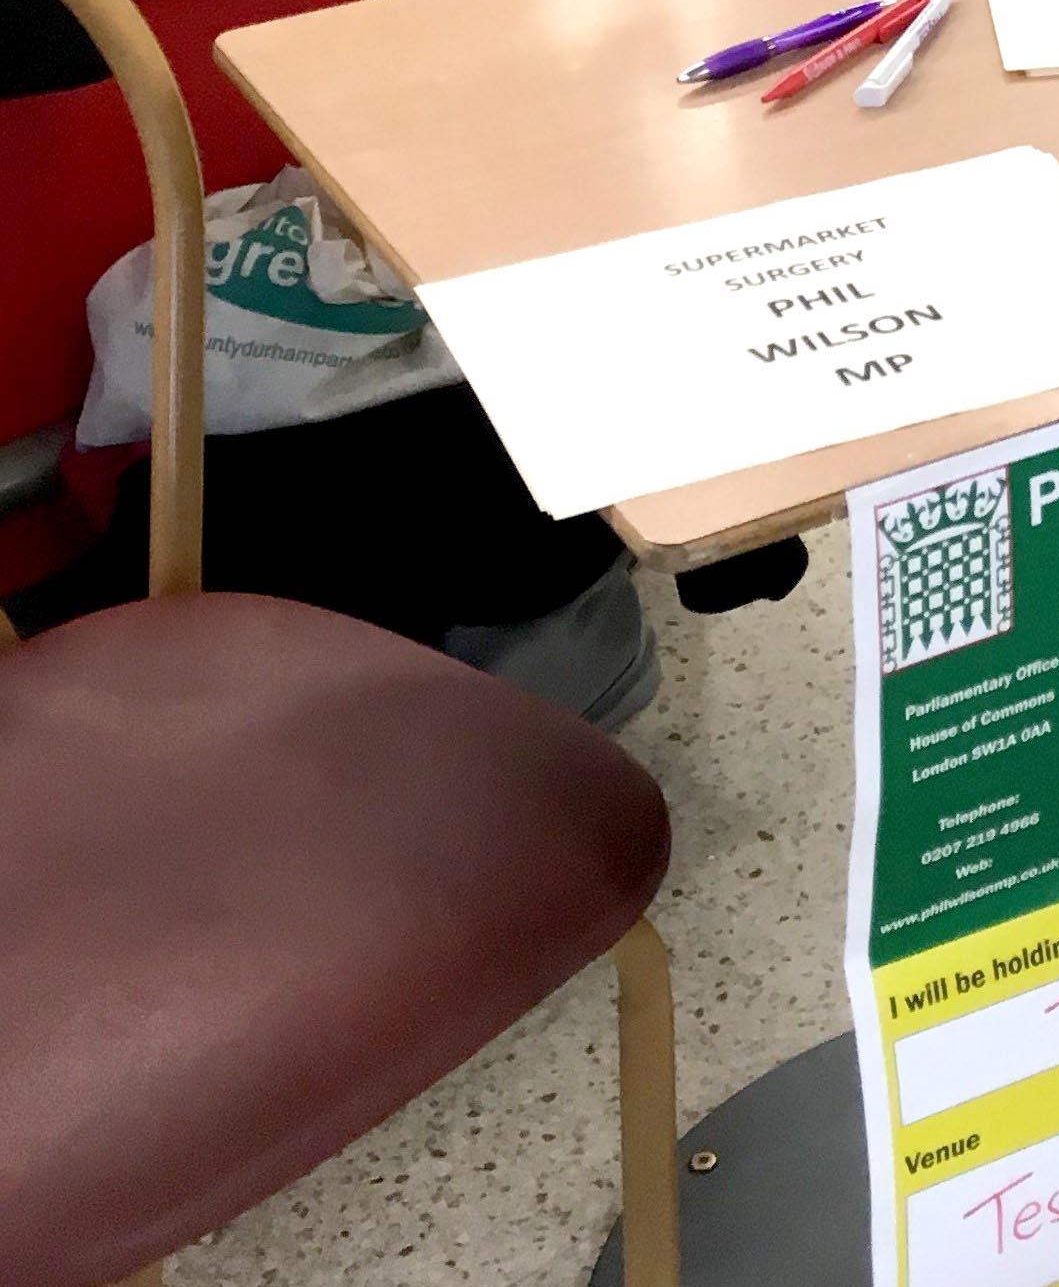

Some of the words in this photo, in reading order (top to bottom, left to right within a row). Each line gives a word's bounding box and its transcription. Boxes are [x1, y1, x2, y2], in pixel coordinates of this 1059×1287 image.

[664, 217, 888, 276] SUPERMARKET
[724, 249, 864, 292] SURGERY
[767, 282, 875, 318] PHIL
[748, 304, 943, 363] WILSON
[835, 353, 914, 386] MP
[905, 673, 1012, 720] Parliamentary
[1016, 657, 1059, 681] Office
[910, 727, 957, 752] House
[962, 715, 977, 732] of
[980, 690, 1056, 726] Commons
[912, 753, 967, 783] London
[971, 735, 1017, 761] SW1A
[1021, 720, 1052, 743] 0AA
[939, 794, 1020, 831] Telephone:
[921, 839, 962, 865] 0207
[966, 828, 997, 850] 219
[955, 858, 993, 880] Web:
[880, 858, 1059, 935] www.philwilsonmp.co.uk
[888, 995, 899, 1019] I
[904, 976, 949, 1013] will
[955, 966, 986, 994] be
[905, 1134, 981, 1175] Venue
